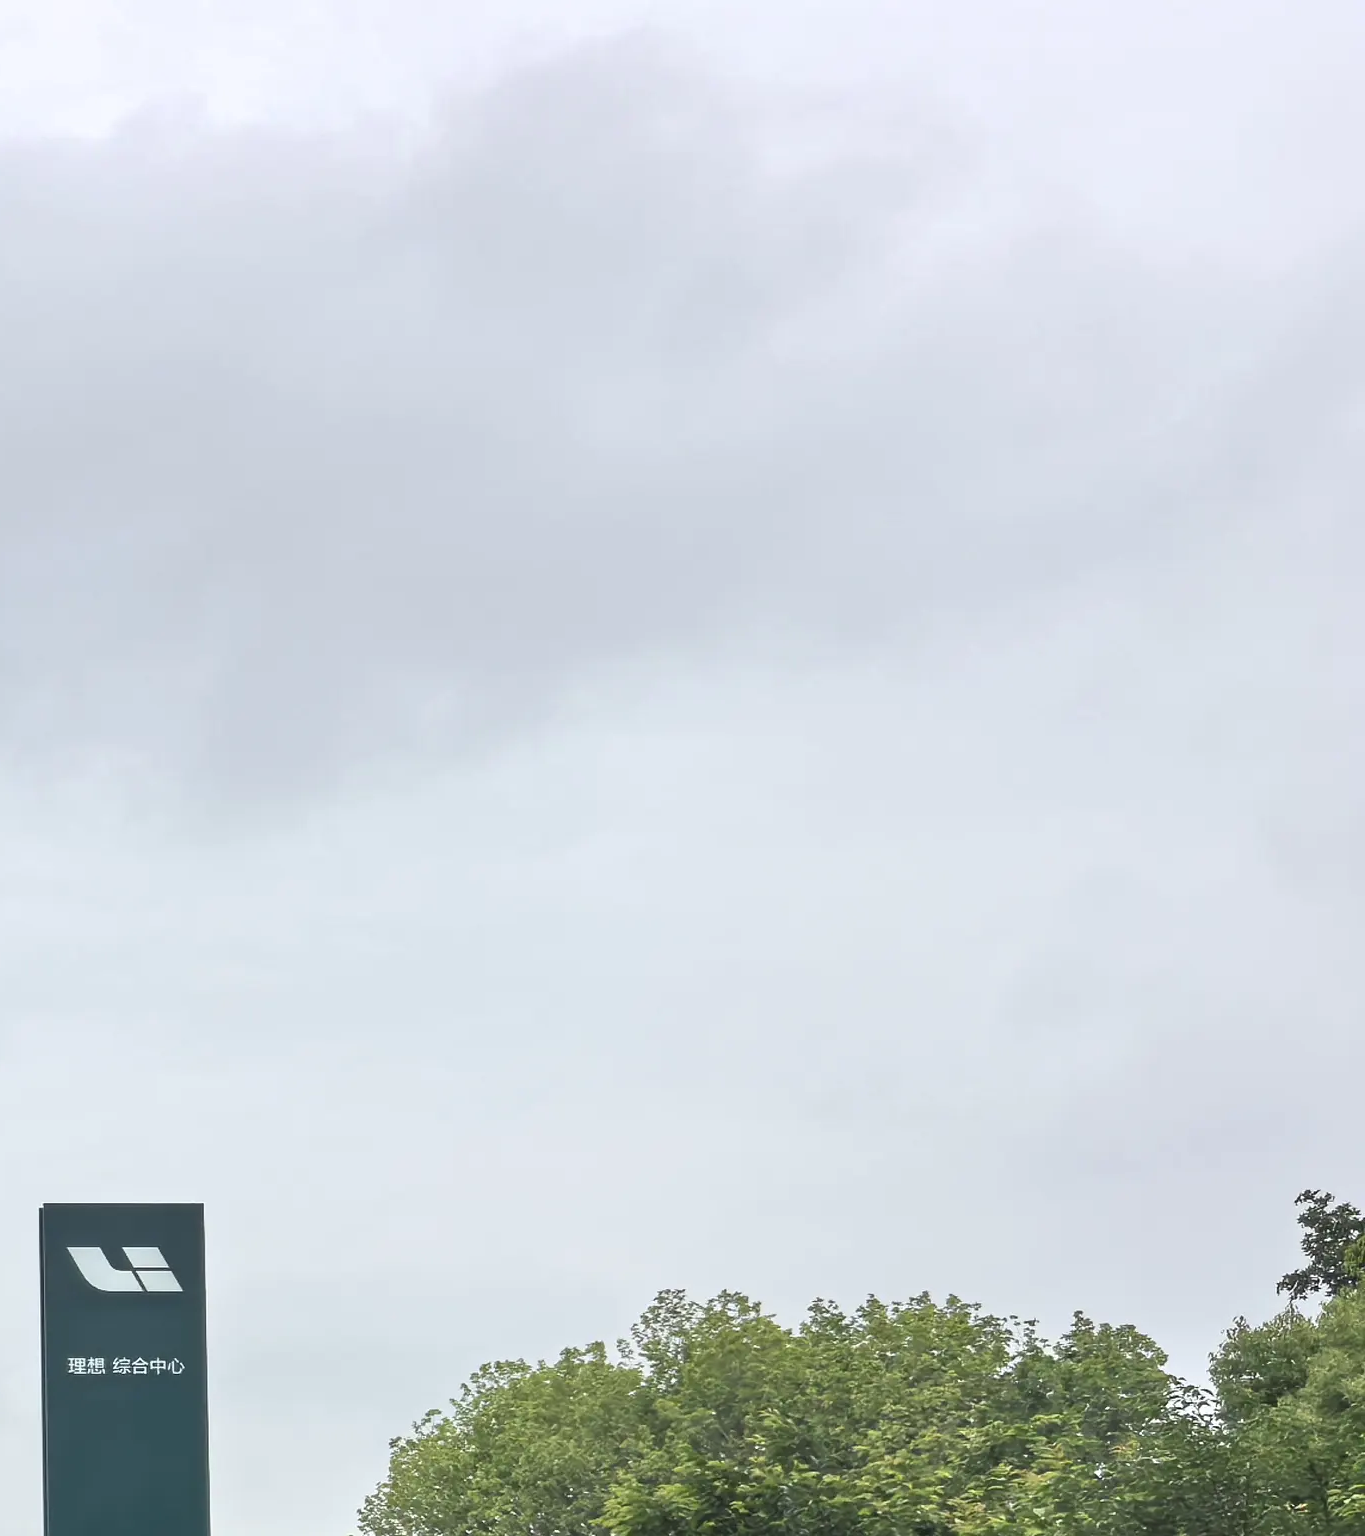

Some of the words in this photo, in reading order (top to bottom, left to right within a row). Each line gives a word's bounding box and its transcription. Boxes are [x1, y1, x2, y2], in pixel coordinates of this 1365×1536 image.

[67, 1356, 106, 1375] 理想
[112, 1356, 186, 1375] 综合中心
